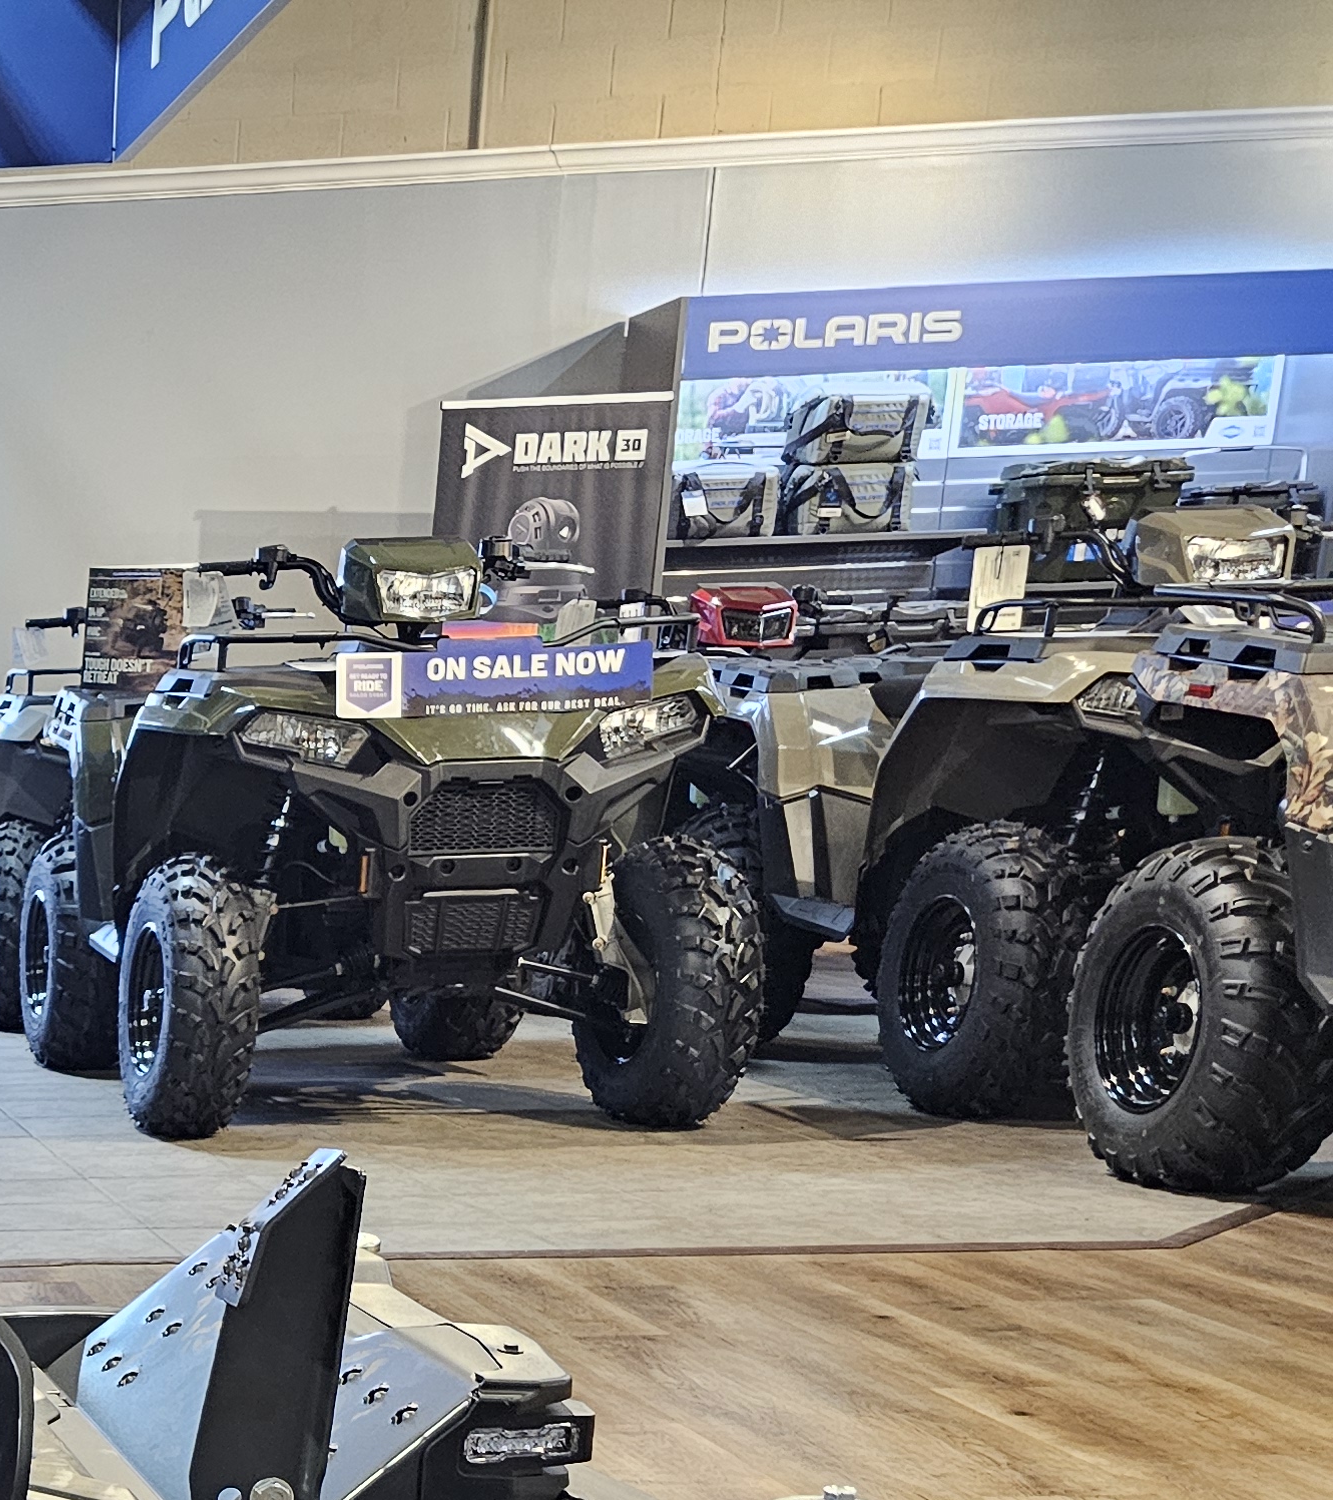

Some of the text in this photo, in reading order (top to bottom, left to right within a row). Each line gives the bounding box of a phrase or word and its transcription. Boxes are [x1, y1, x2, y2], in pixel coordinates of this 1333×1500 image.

[707, 310, 963, 353] POLARIS
[978, 412, 1044, 431] STORAGE
[675, 427, 722, 443] ORAGE
[513, 430, 642, 465] DARK 30
[110, 658, 153, 673] DOESN'T
[426, 648, 626, 681] ON SALE NOW
[353, 680, 384, 692] RIDE
[425, 696, 626, 715] IT'S GO TIME. ASK FOR OUR BEST DEAL.
